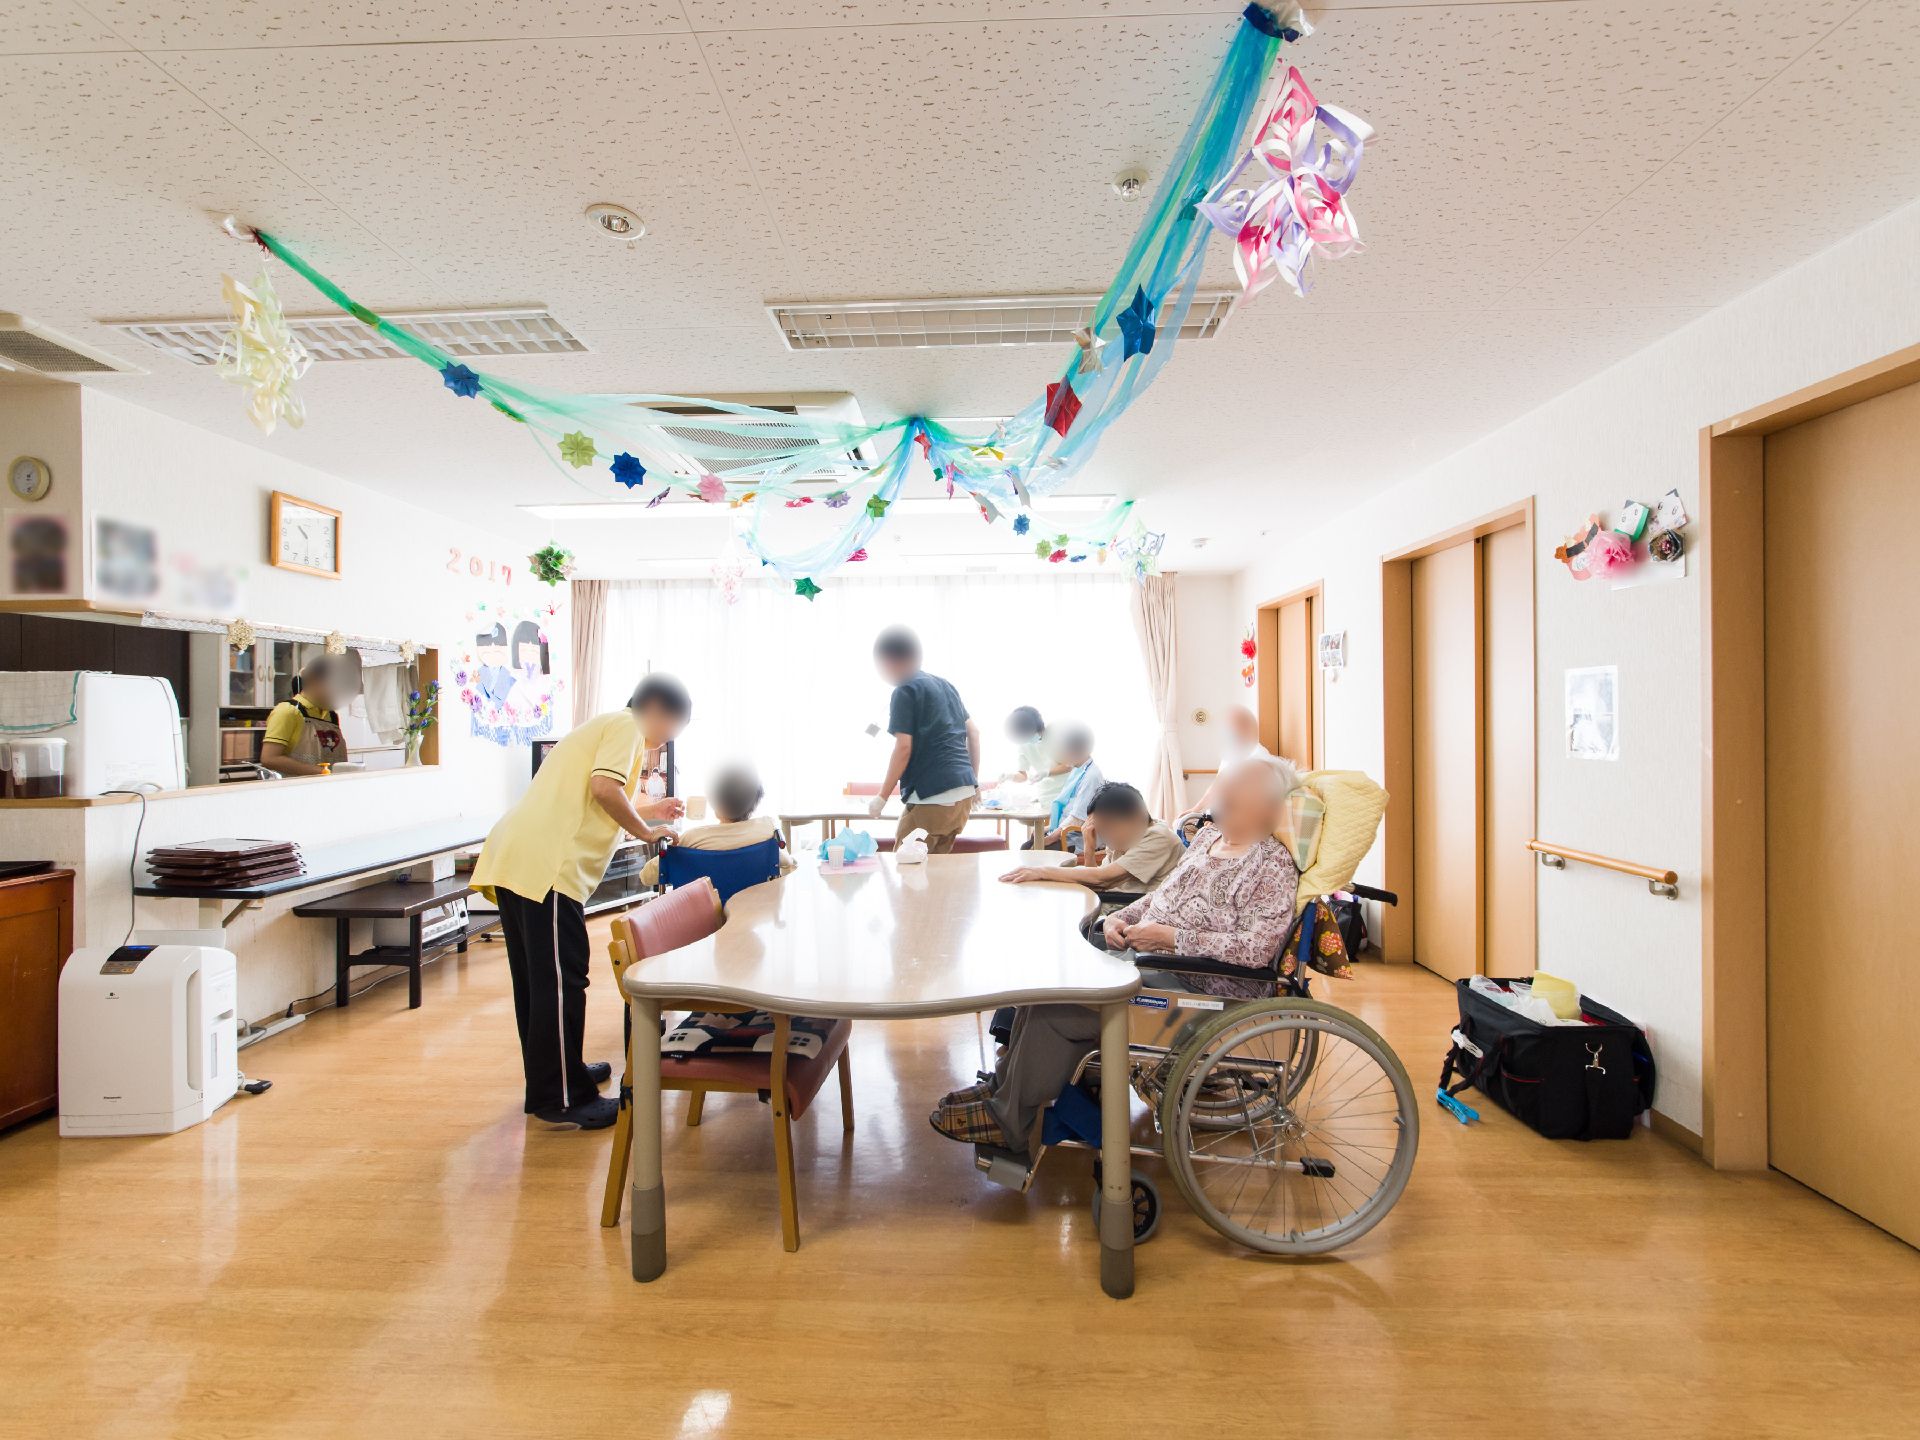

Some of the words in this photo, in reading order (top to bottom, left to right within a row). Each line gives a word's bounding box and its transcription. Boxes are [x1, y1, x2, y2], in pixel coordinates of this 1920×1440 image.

[323, 526, 330, 535] 2
[292, 552, 299, 561] 7
[446, 547, 512, 586] 2017
